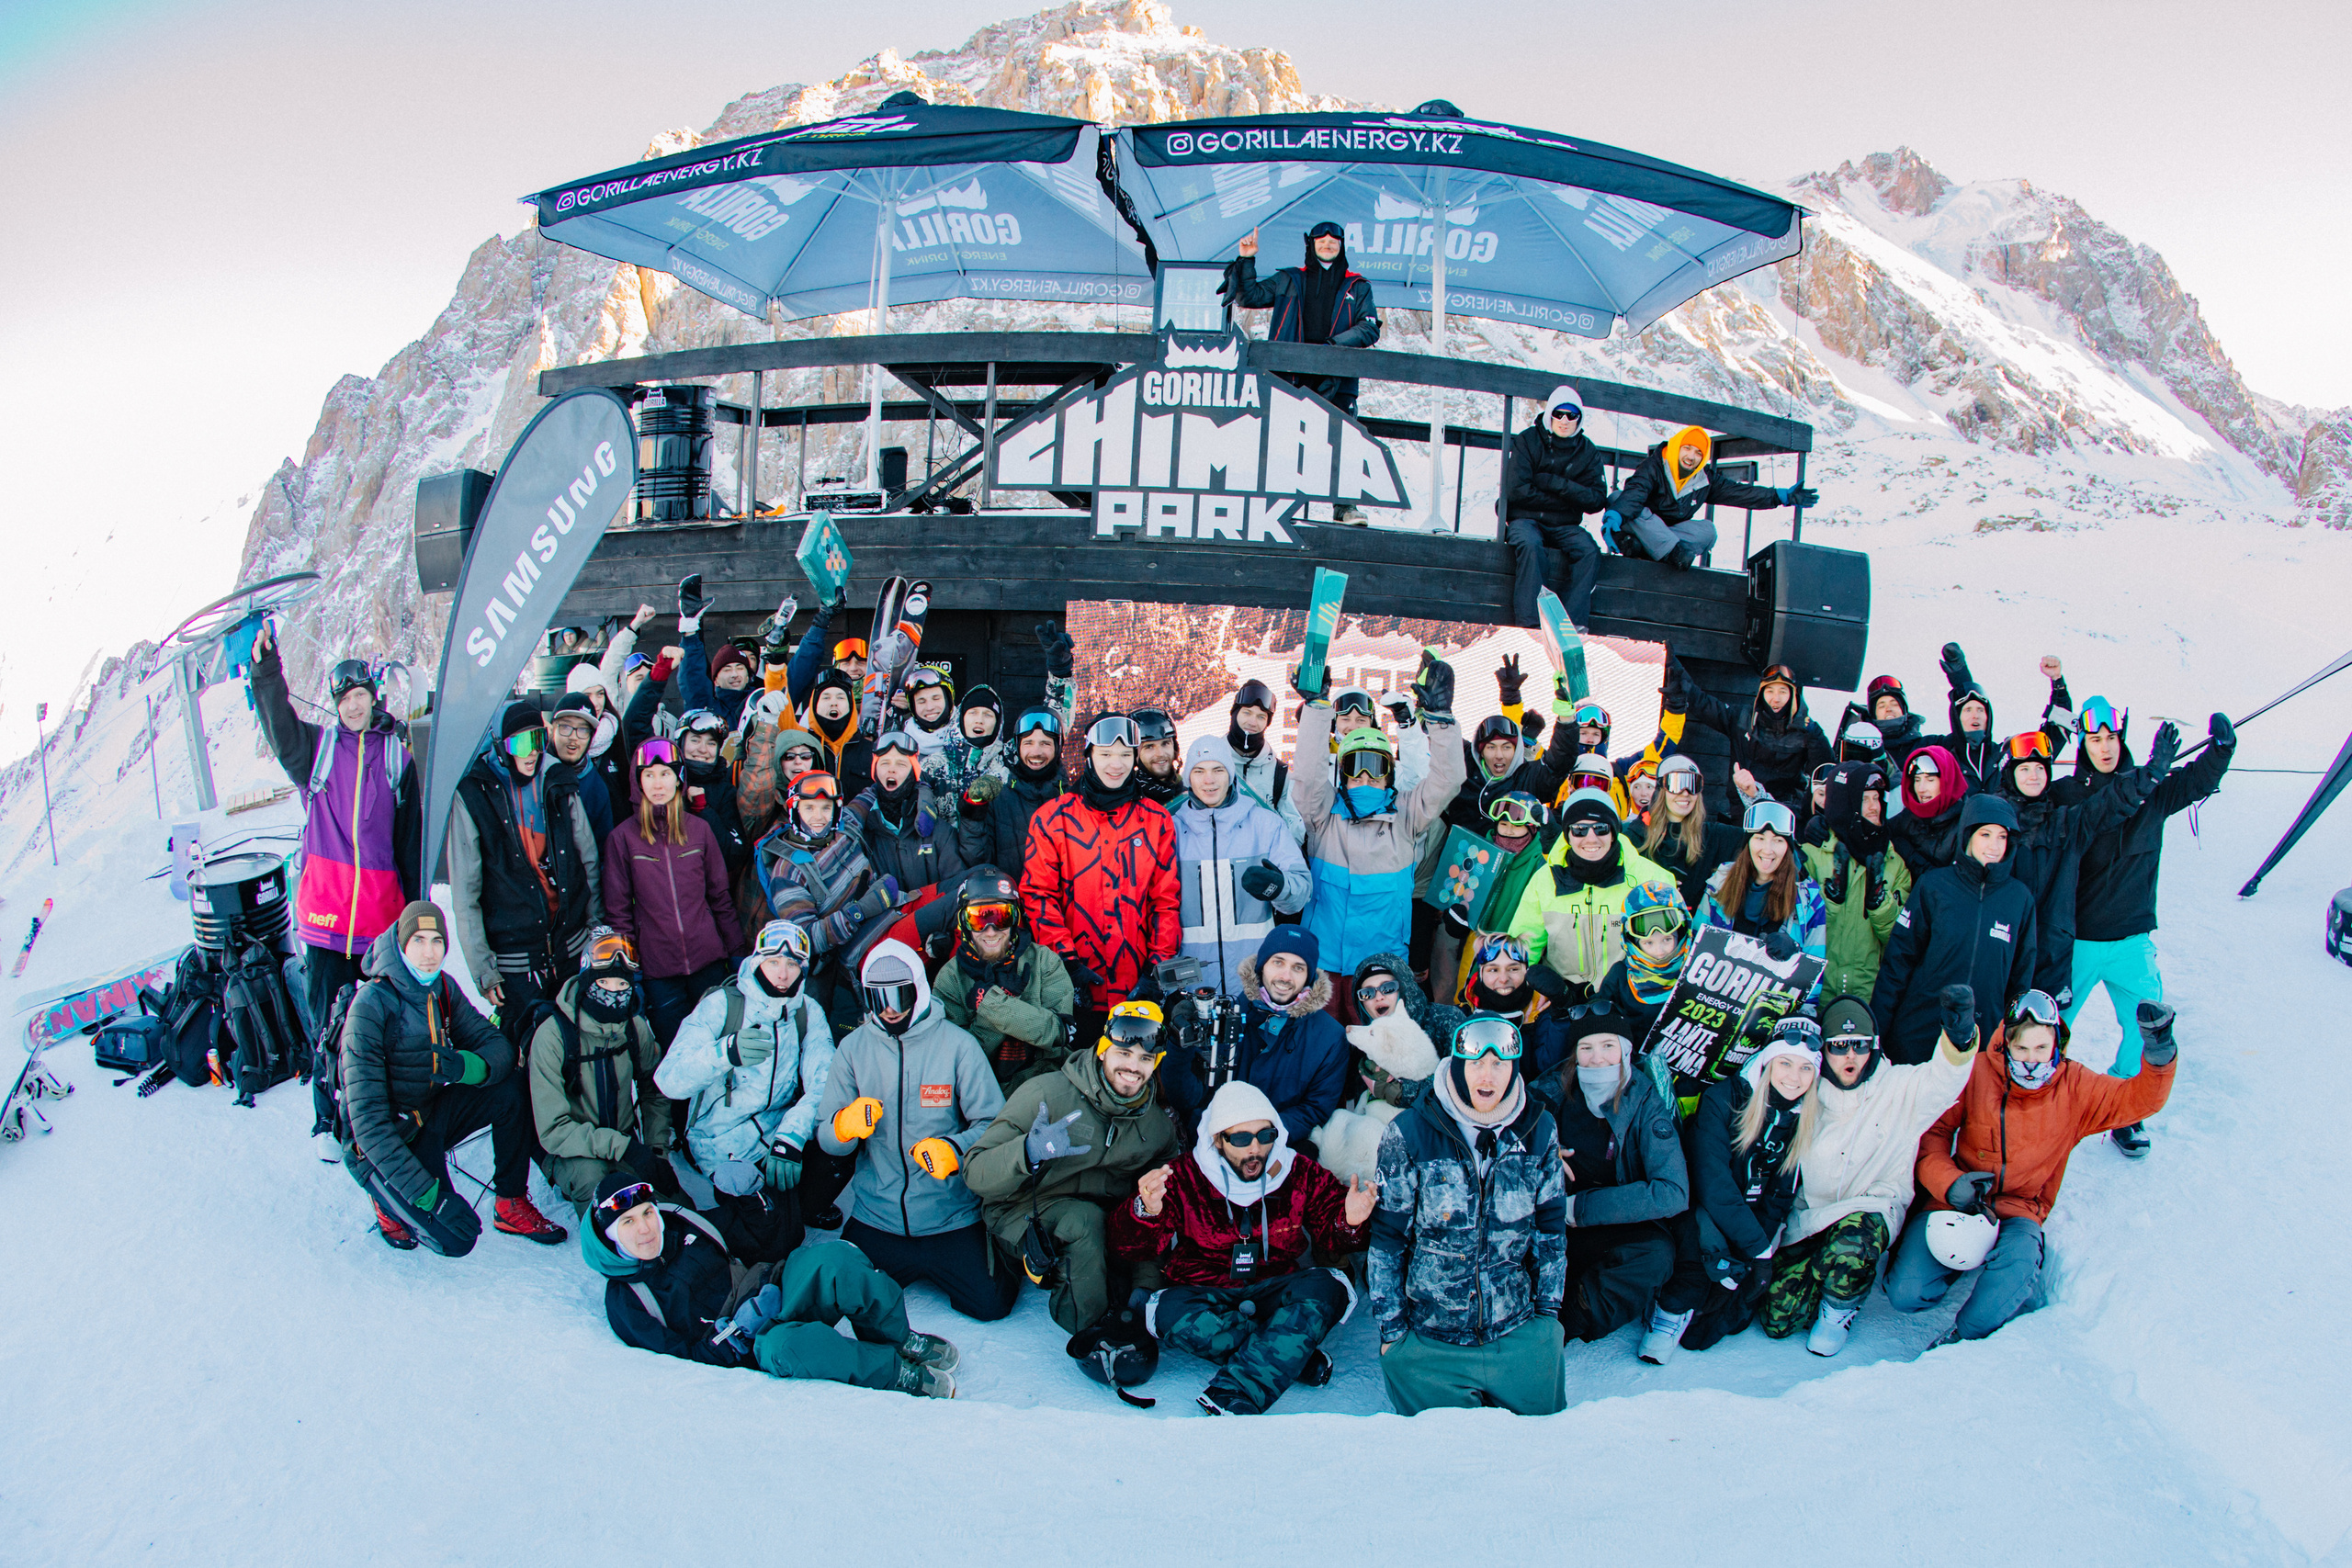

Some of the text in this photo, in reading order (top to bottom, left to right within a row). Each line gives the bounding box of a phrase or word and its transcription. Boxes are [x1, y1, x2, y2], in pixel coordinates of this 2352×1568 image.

[1197, 129, 1464, 155] GORILLAENERGY.KZ
[576, 147, 763, 207] GORILLAENERGY.KZ
[1143, 370, 1261, 409] GORILLA
[998, 377, 1405, 504] CHIMBA
[1097, 491, 1295, 544] PARK
[466, 441, 617, 668] SAMSUNG
[256, 886, 279, 905] GORILLA
[307, 912, 339, 929] neff
[1679, 998, 1727, 1029] 2023
[1695, 992, 1735, 1011] ENERGY
[1660, 1017, 1719, 1055] ДАЙТЕ
[922, 1086, 950, 1098] Analog
[1236, 1257, 1254, 1265] GORILLA
